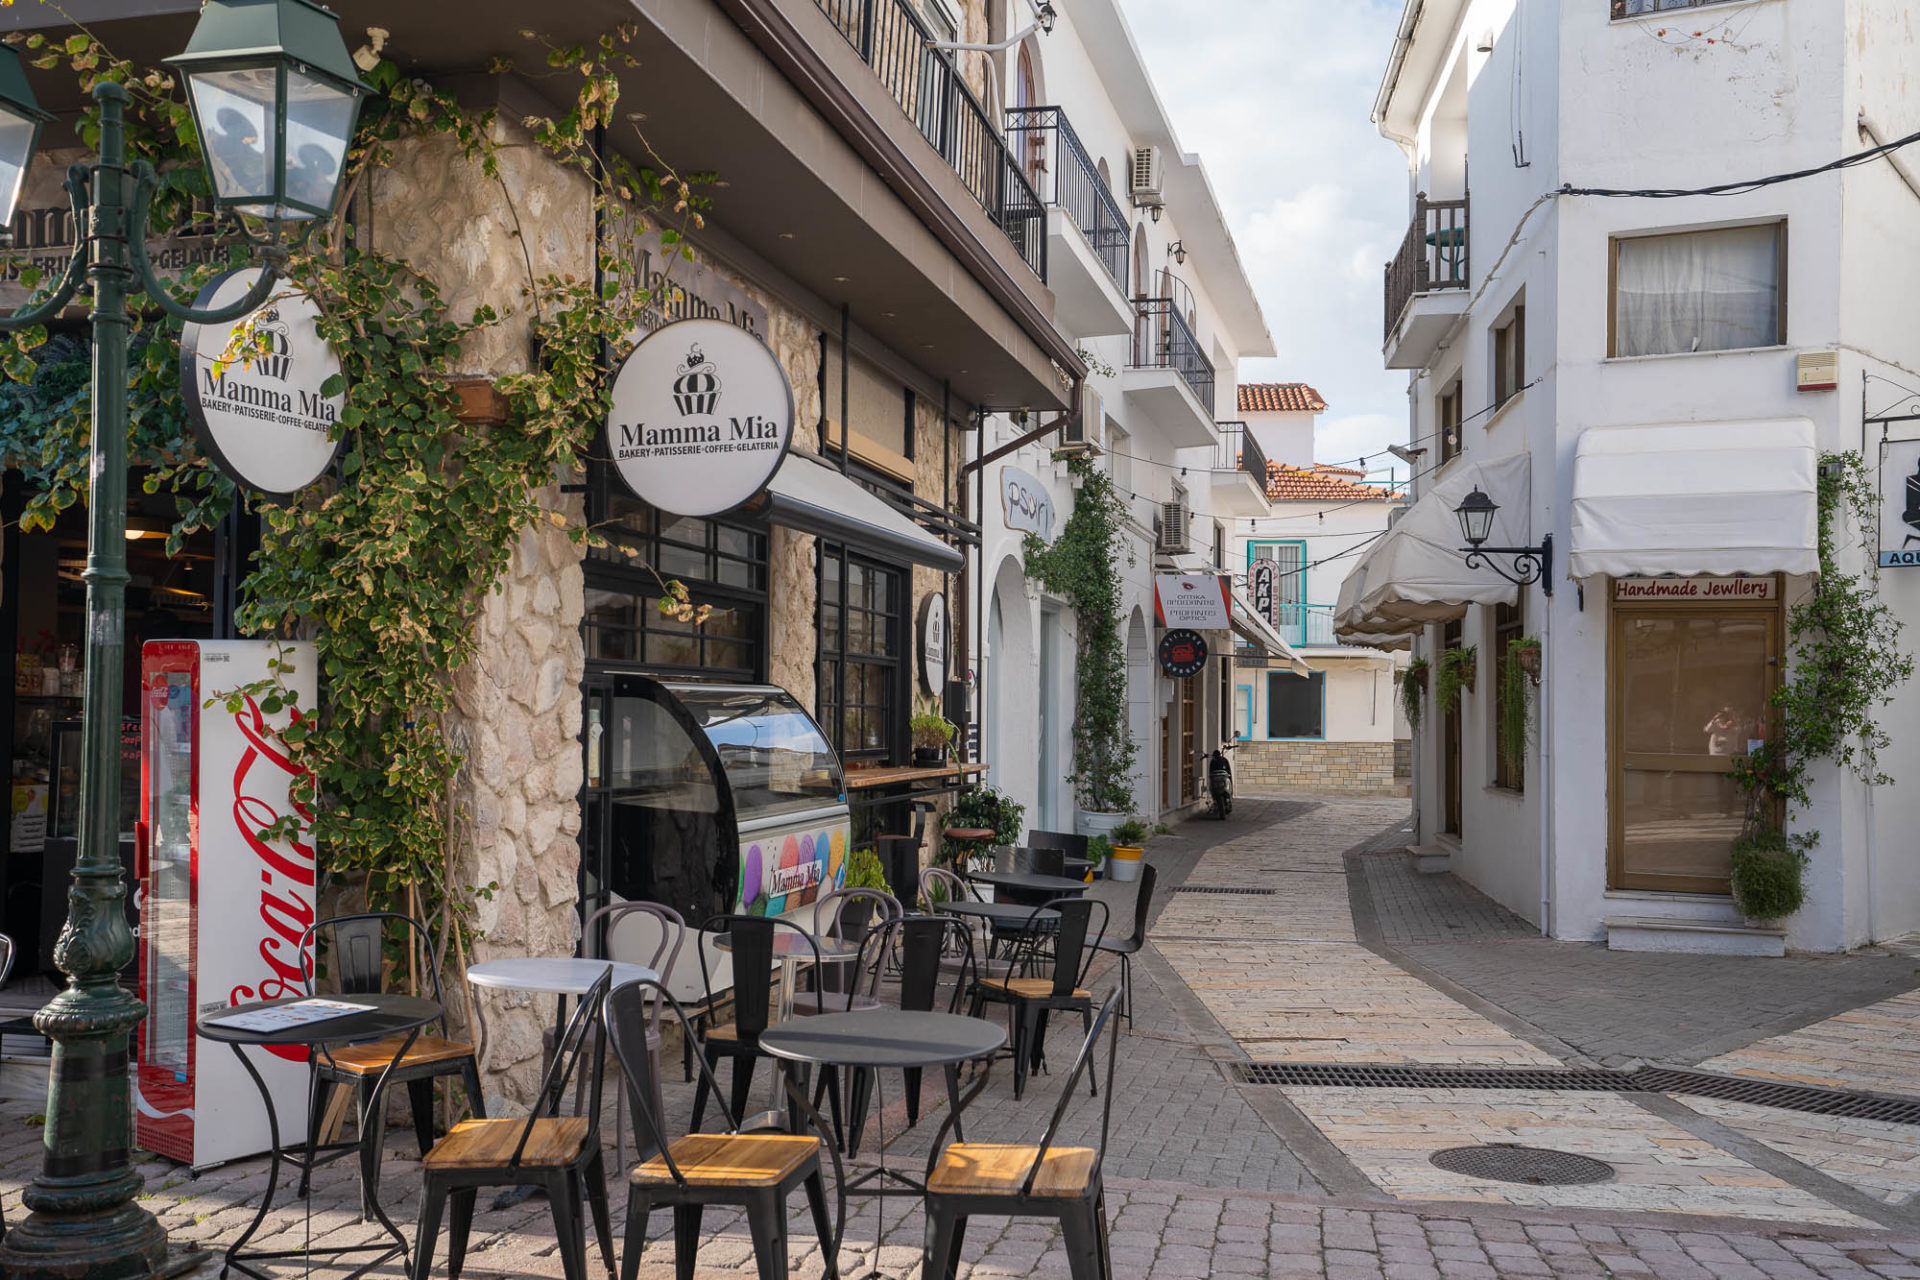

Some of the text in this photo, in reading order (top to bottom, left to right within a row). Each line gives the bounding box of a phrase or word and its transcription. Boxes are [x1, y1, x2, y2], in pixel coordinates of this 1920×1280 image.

[202, 367, 336, 422] Mamma Mia
[201, 397, 231, 413] BAKERY
[234, 404, 276, 422] PATISSERIE
[278, 414, 302, 428] COFFEE
[619, 415, 779, 448] Mamma Mia
[618, 441, 779, 459] BAKERY PATISSERIE COFFEE GELATERIA
[1616, 579, 1768, 598] Handmade Jewllery
